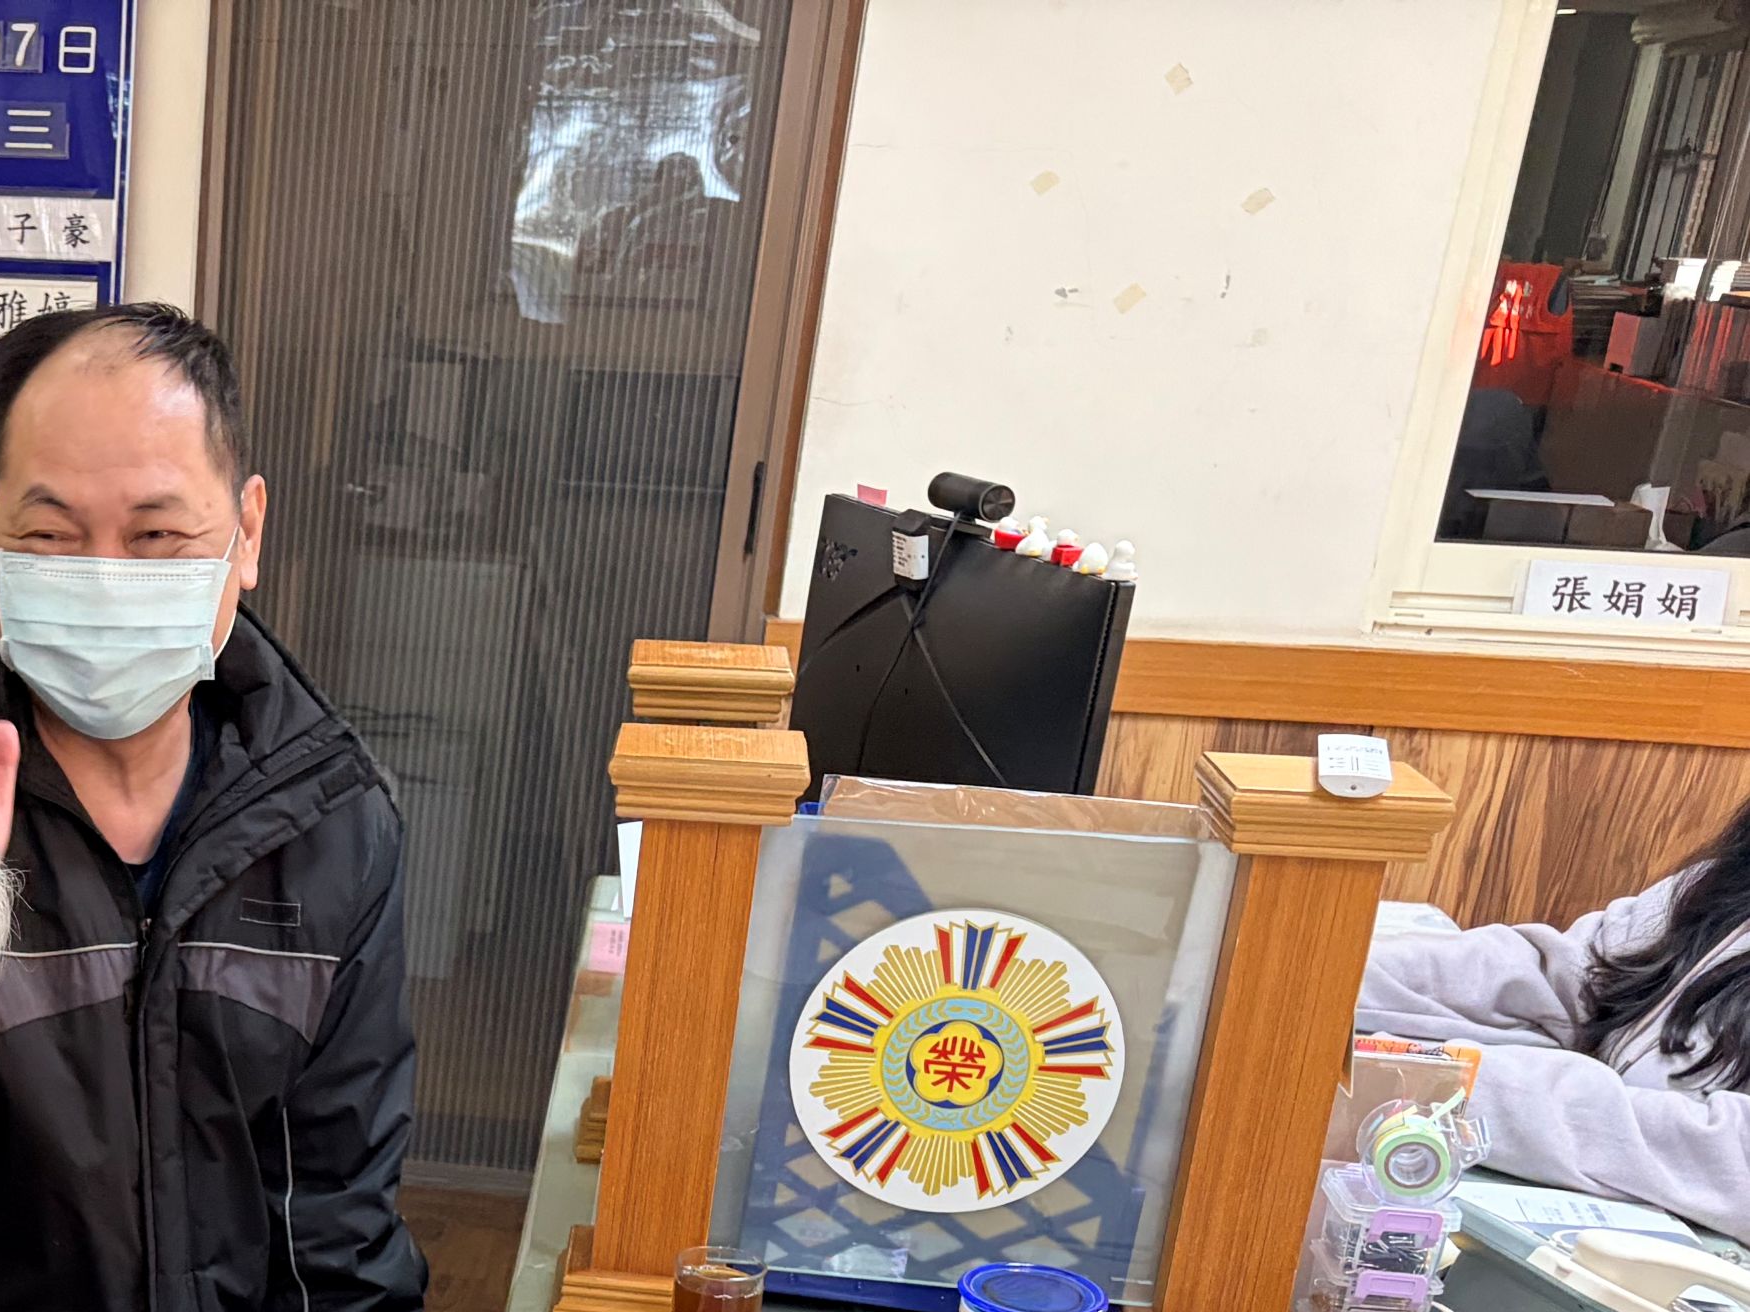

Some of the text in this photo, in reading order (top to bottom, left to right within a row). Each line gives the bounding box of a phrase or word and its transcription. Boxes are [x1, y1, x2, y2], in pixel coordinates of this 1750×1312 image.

[1551, 575, 1702, 622] 張娟娟
[923, 1035, 987, 1093] 榮
